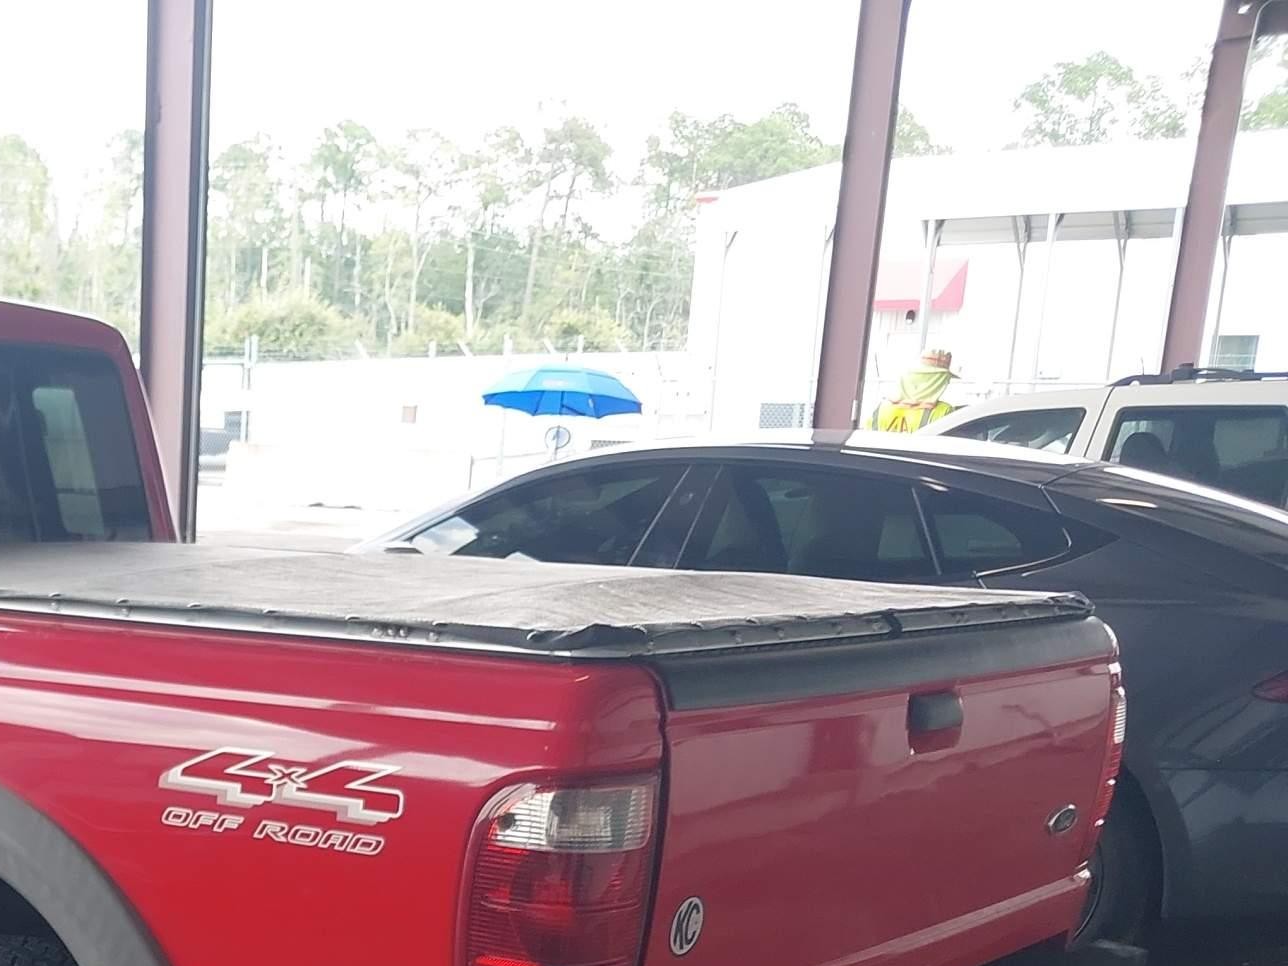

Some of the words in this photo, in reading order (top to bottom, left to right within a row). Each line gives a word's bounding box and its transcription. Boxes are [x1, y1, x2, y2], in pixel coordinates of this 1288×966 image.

[161, 806, 245, 833] OFF
[253, 820, 385, 856] ROAD
[673, 900, 701, 950] KC
